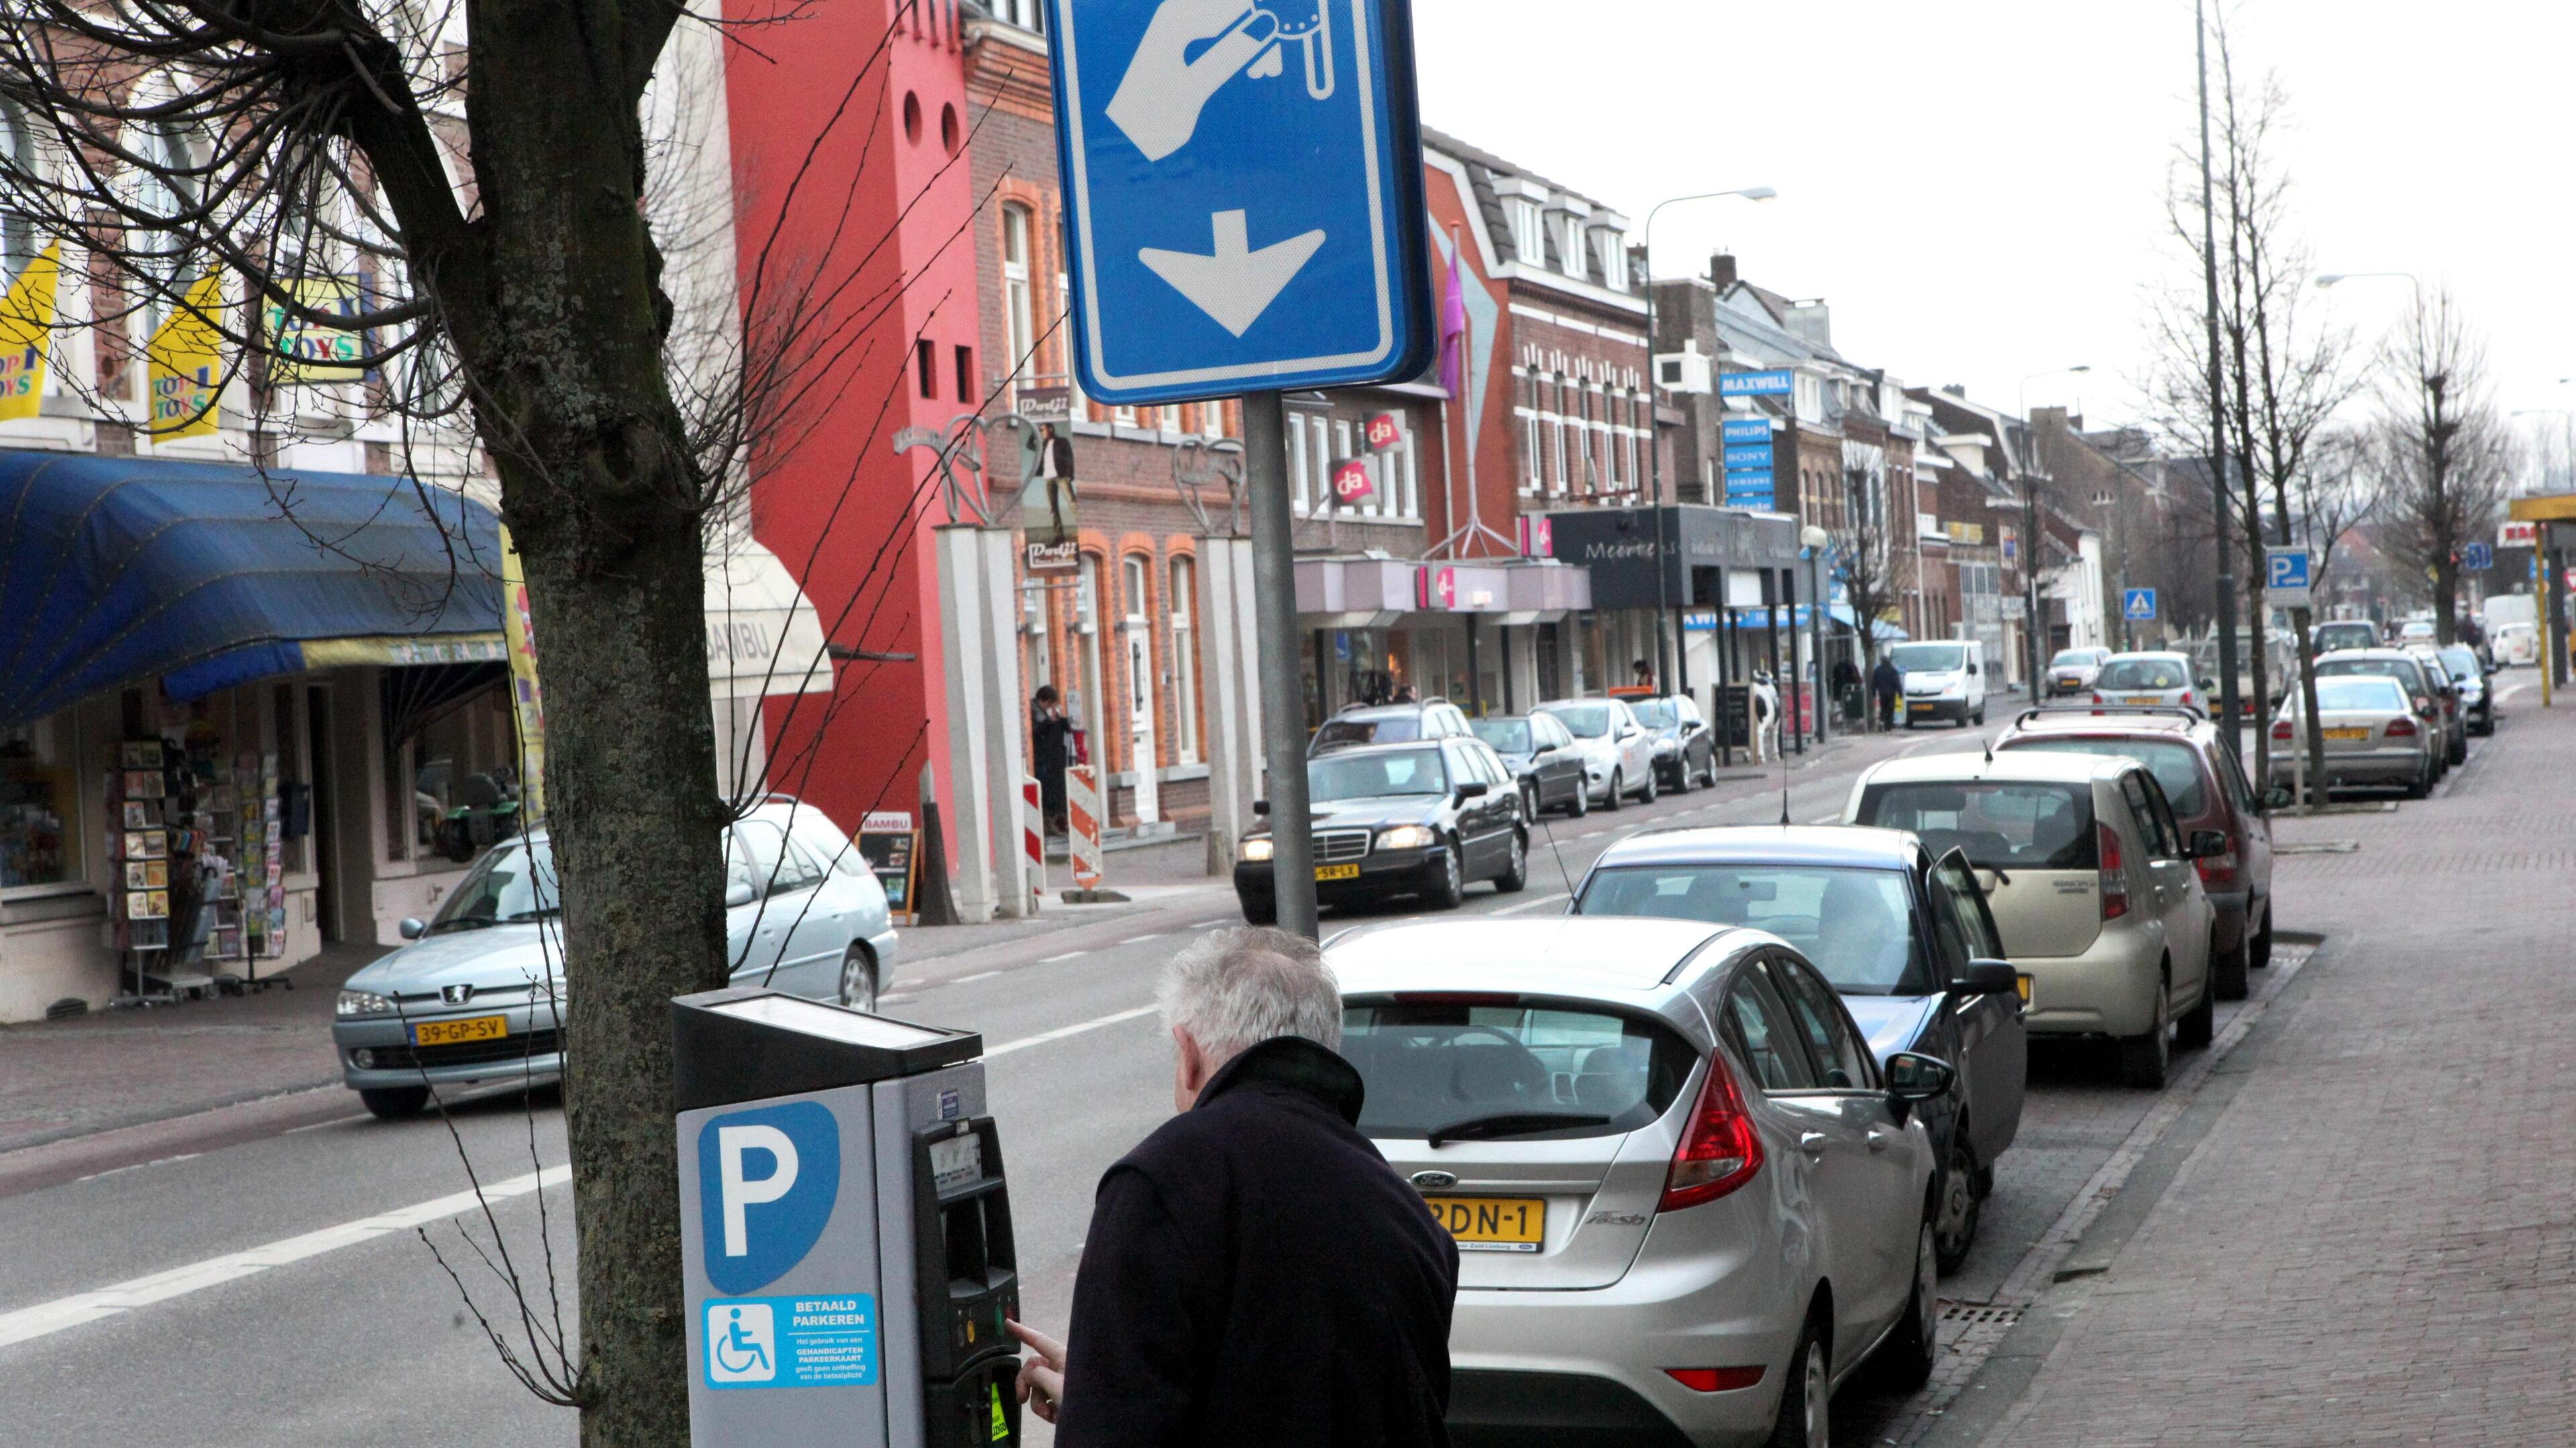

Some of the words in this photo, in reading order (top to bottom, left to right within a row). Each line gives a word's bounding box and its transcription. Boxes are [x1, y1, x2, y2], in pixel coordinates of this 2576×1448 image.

[1722, 376, 1789, 392] MAXWELL
[156, 394, 206, 419] TOYS
[1369, 422, 1392, 443] da
[1725, 425, 1768, 437] PHILIPS
[1726, 451, 1768, 463] SONY
[1336, 470, 1363, 496] da
[2271, 557, 2292, 586] P
[865, 820, 908, 830] BAMBU
[420, 1020, 498, 1042] 39-GP-SV
[1420, 1175, 1446, 1187] Ford
[718, 1125, 799, 1257] P
[796, 1300, 857, 1313] BETAALD
[793, 1315, 865, 1327] PARKEREN
[796, 1347, 863, 1355] GEHANDICAPTEN
